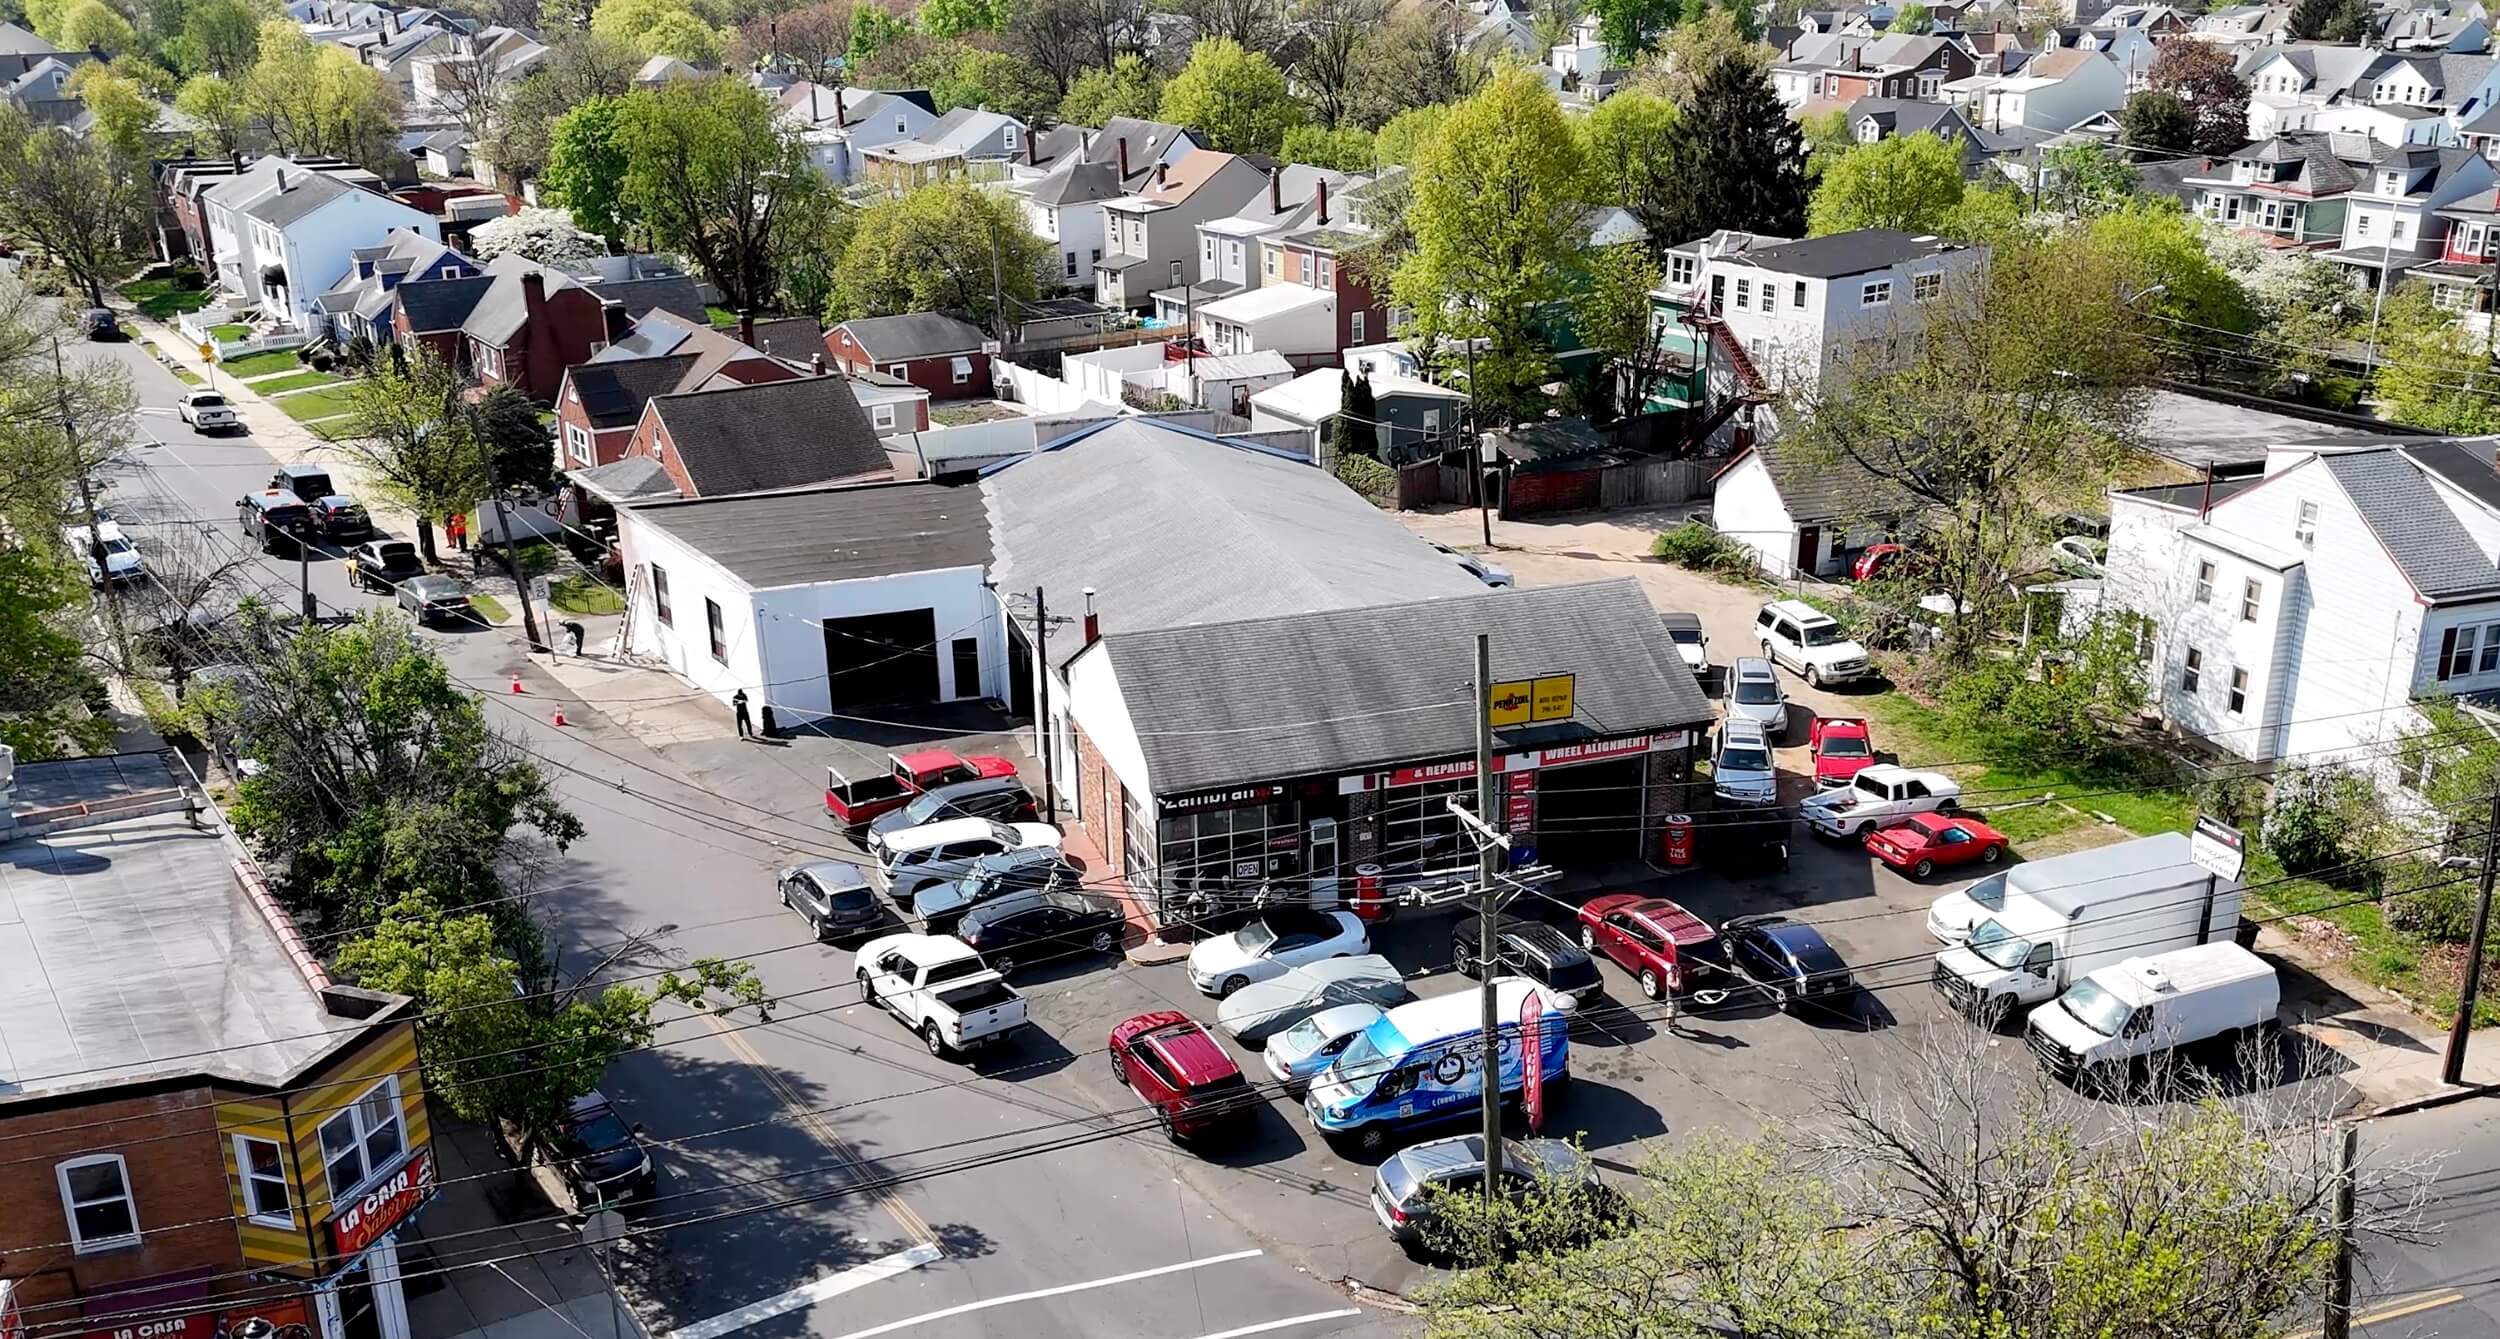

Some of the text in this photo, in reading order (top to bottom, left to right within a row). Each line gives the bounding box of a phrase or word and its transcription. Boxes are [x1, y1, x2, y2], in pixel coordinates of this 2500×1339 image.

[1545, 746, 1582, 760] WHEEL
[1584, 736, 1648, 755] ALIGNMENT
[1414, 761, 1475, 778] & REPAIRS
[1238, 863, 1258, 876] OPEN
[340, 1170, 408, 1233] LA CASA
[114, 1329, 133, 1339] LA
[138, 1319, 186, 1336] CASA
